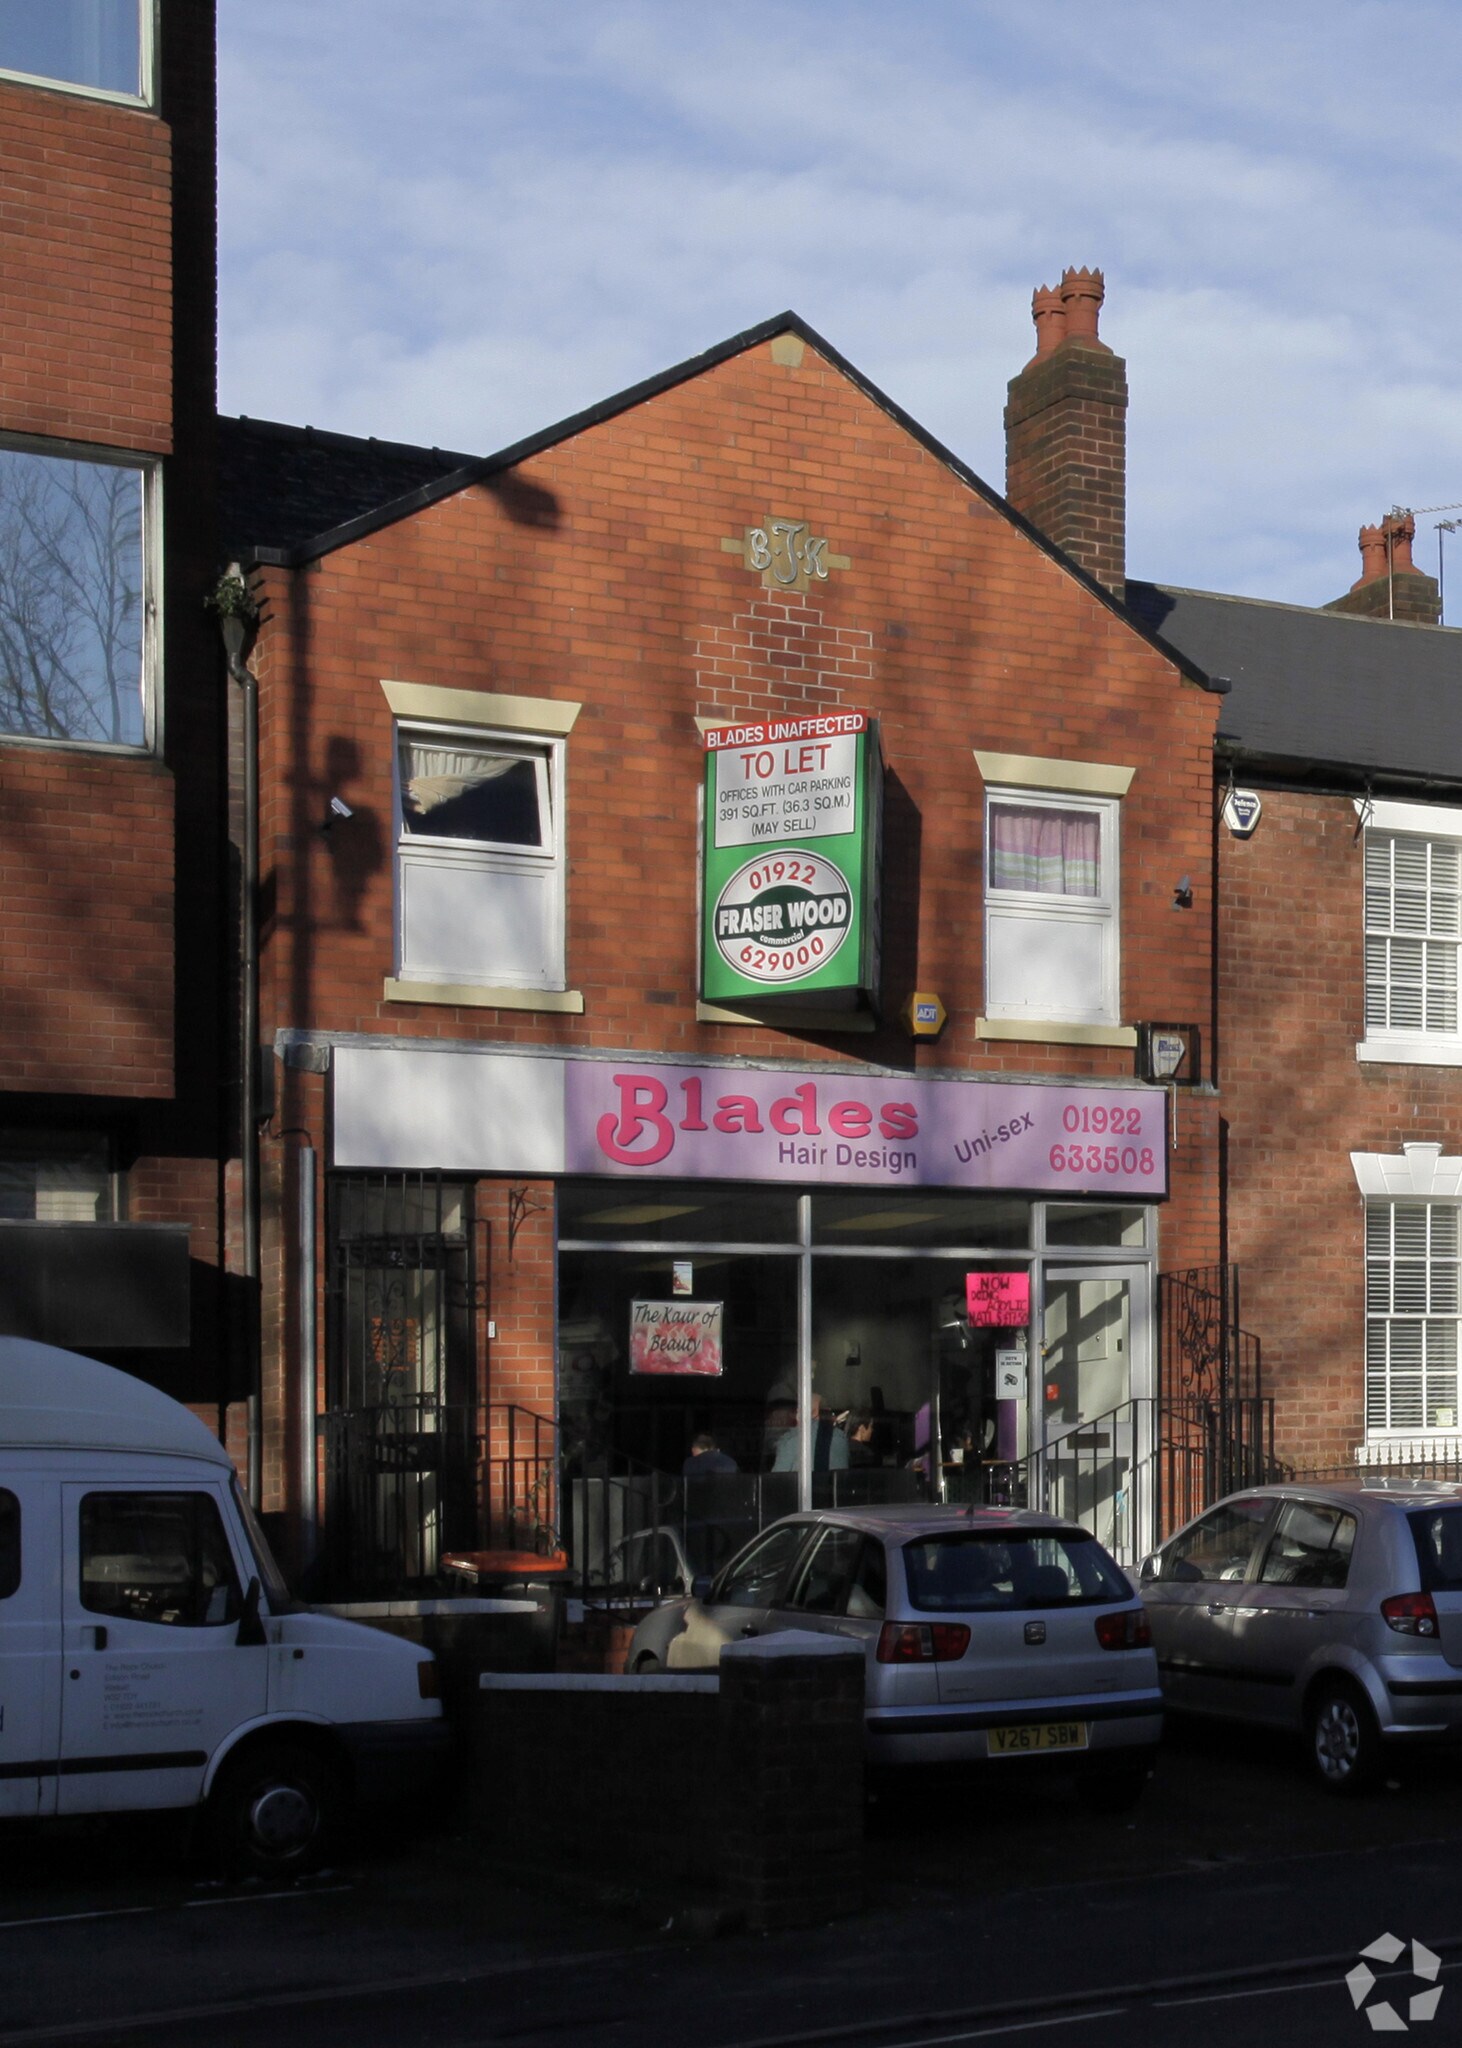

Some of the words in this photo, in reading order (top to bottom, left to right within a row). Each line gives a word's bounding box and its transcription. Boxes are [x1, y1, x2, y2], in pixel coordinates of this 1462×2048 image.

[707, 725, 764, 748] BLADES
[768, 713, 864, 741] UNAFFECTED
[740, 751, 775, 780] TO
[784, 743, 832, 775] LET
[719, 786, 759, 803] OFFICES
[762, 784, 785, 798] WITH
[788, 782, 808, 795] CAR
[810, 776, 851, 792] PARKING
[719, 807, 739, 822] 391
[783, 799, 810, 816] (36.3
[814, 793, 851, 810] SQ.M.)
[751, 820, 779, 837] (MAY
[783, 816, 817, 832] SELL)
[749, 861, 816, 890] 01922
[718, 904, 783, 936] FRASER
[787, 897, 847, 927] WOOD
[759, 929, 805, 946] commercial
[740, 936, 824, 971] 629000
[917, 1007, 937, 1020] ADT
[596, 1073, 920, 1166] Blades
[1062, 1103, 1142, 1136] 01922
[953, 1108, 1036, 1164] Uni-sex
[778, 1140, 828, 1168] Hair
[835, 1143, 918, 1175] Design
[1048, 1143, 1155, 1176] 633508
[980, 1277, 1010, 1290] NOW
[634, 1304, 661, 1323] The
[663, 1306, 700, 1324] Kaur
[701, 1306, 720, 1328] of
[649, 1334, 701, 1357] Beauty
[996, 1727, 1041, 1749] V267
[1047, 1725, 1079, 1745] SBW
